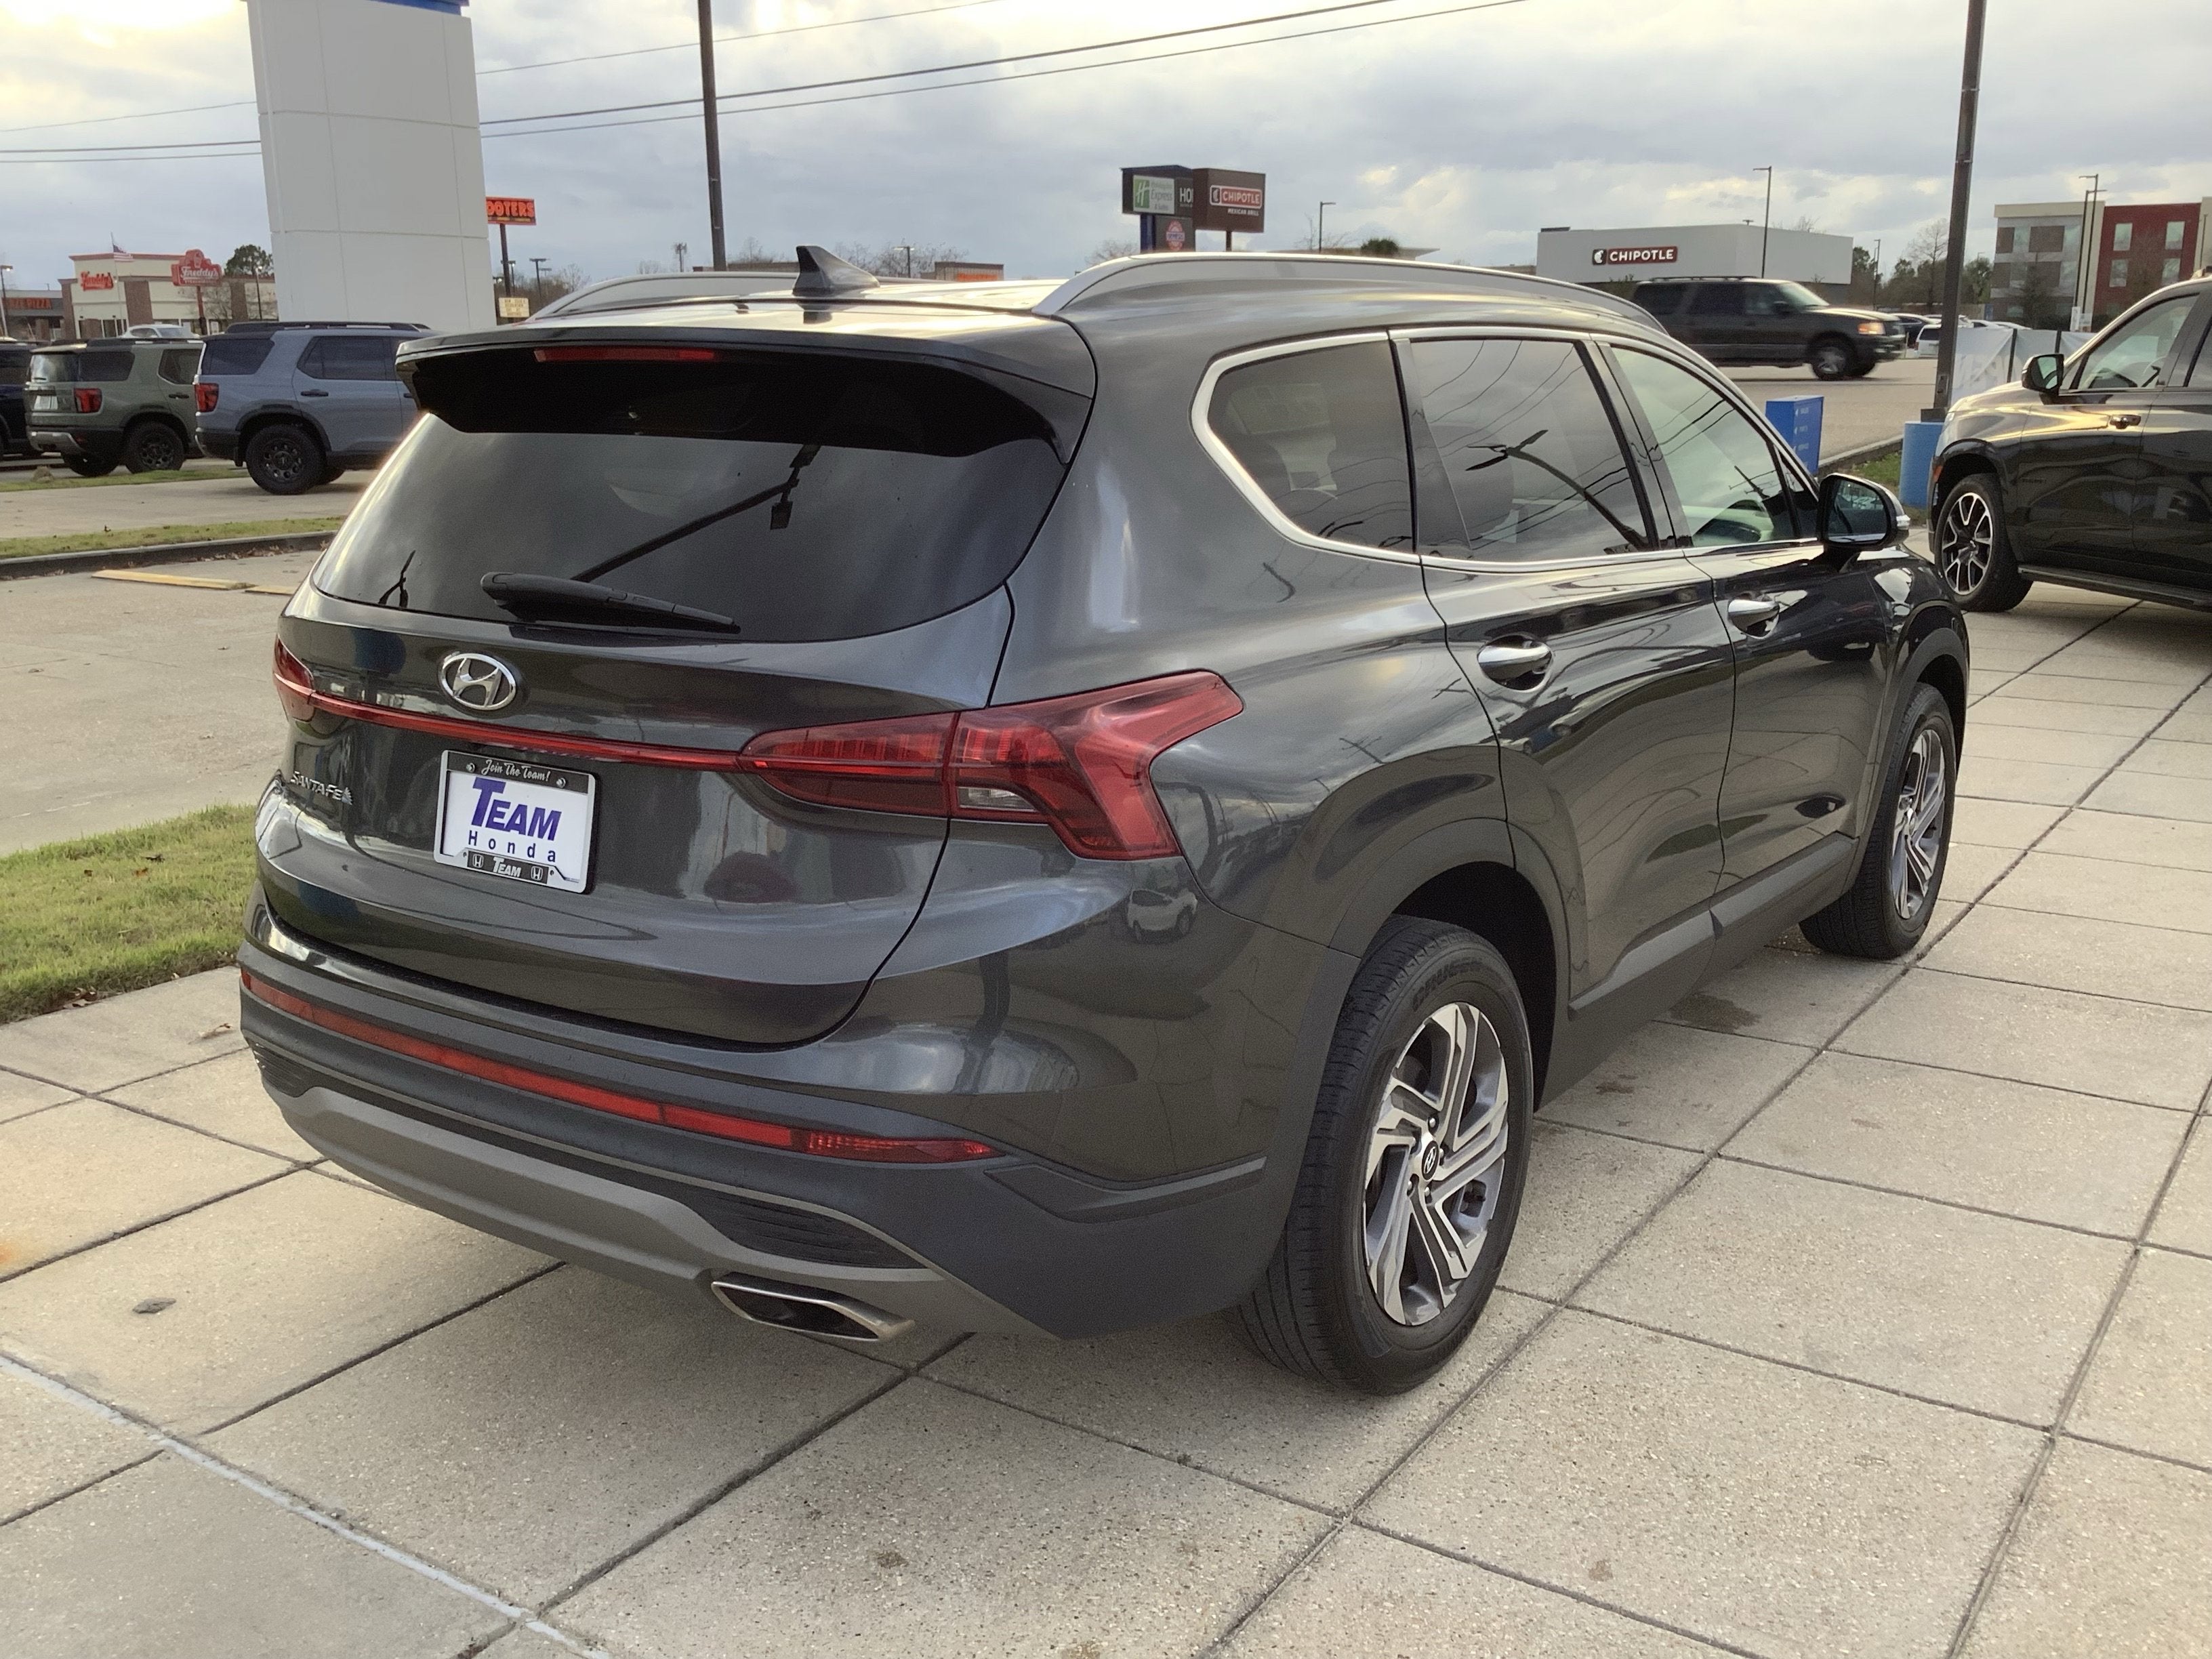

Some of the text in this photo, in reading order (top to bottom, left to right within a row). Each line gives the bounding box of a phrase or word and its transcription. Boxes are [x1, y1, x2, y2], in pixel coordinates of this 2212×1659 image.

[1180, 187, 1193, 203] HO
[1223, 191, 1260, 204] CHIPOTLE
[487, 201, 534, 218] OOTERS
[1610, 249, 1674, 262] CHIPOTLE
[180, 266, 218, 278] Freddy's
[481, 759, 551, 782] Join The Team!
[471, 777, 562, 841] TEAM
[468, 830, 556, 862] Honda
[492, 857, 521, 877] TEAM
